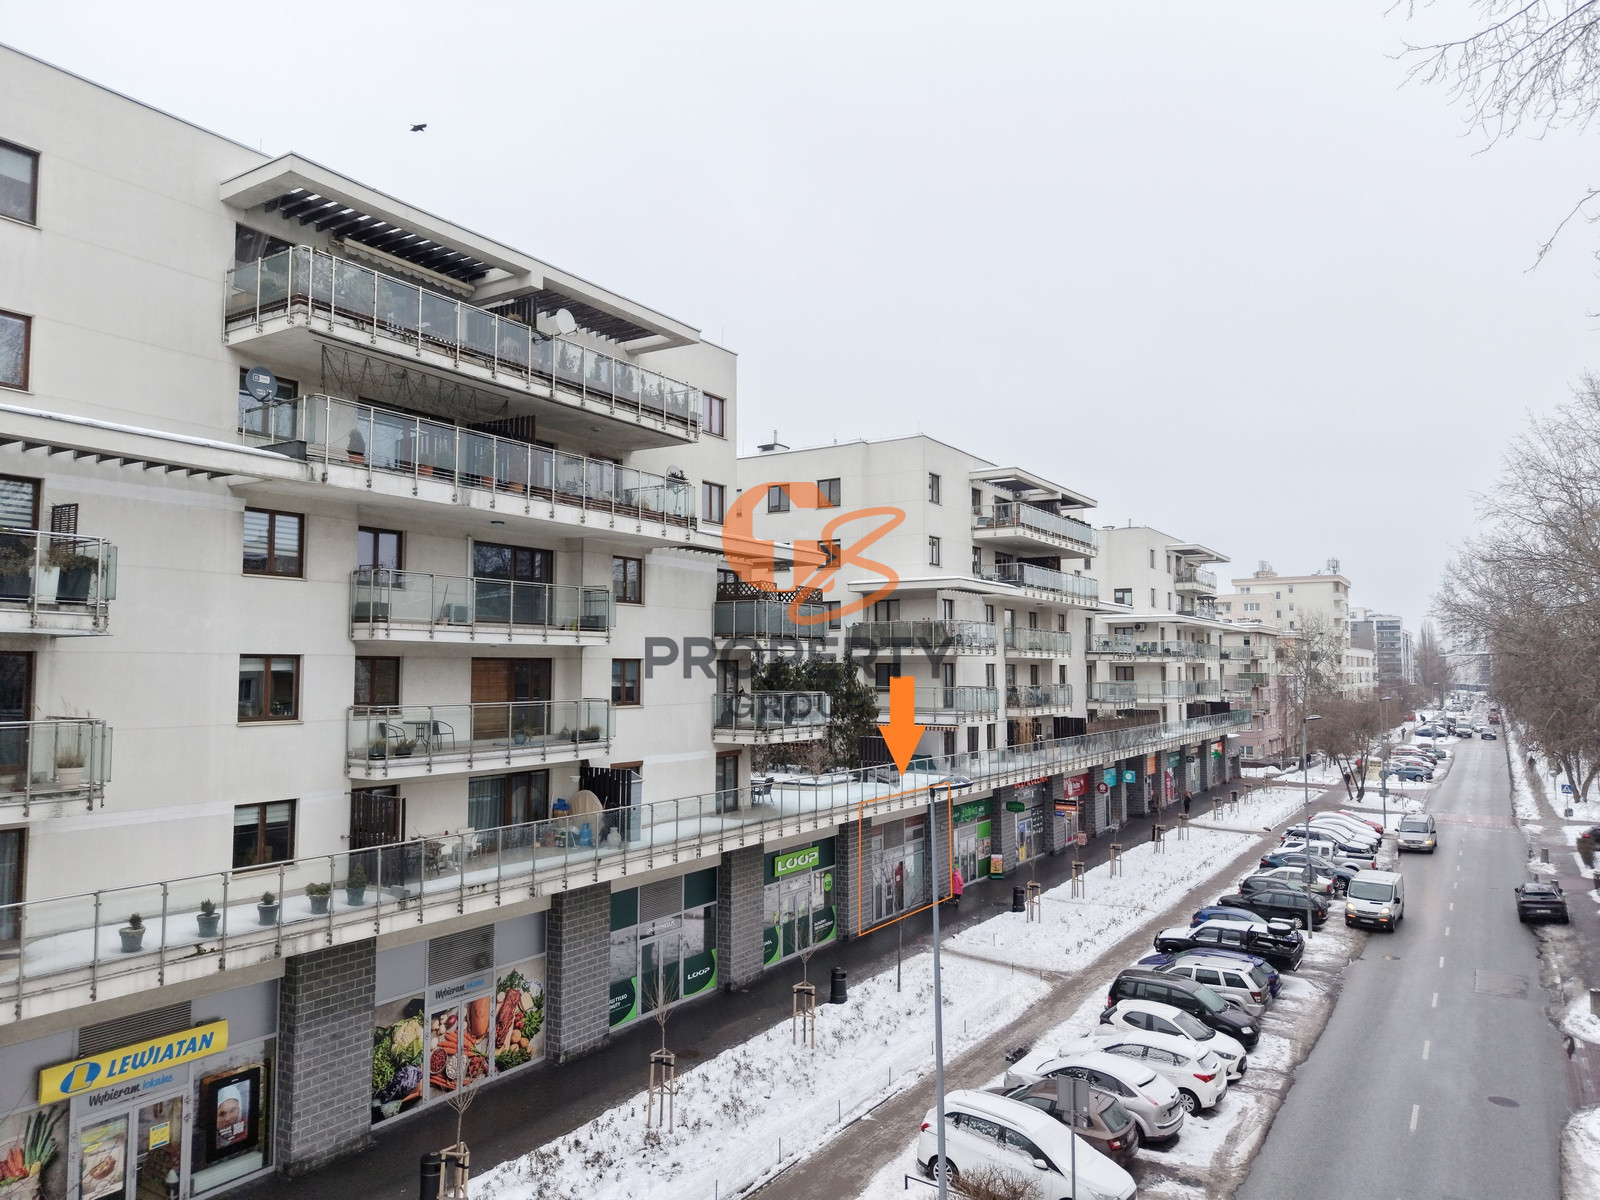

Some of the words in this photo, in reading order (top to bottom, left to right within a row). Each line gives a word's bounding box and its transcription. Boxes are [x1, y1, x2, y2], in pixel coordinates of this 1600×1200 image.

[777, 851, 819, 873] LOOP
[687, 966, 710, 980] LOOP
[106, 1032, 215, 1079] LEWIATAN
[88, 1083, 141, 1108] Wybieram
